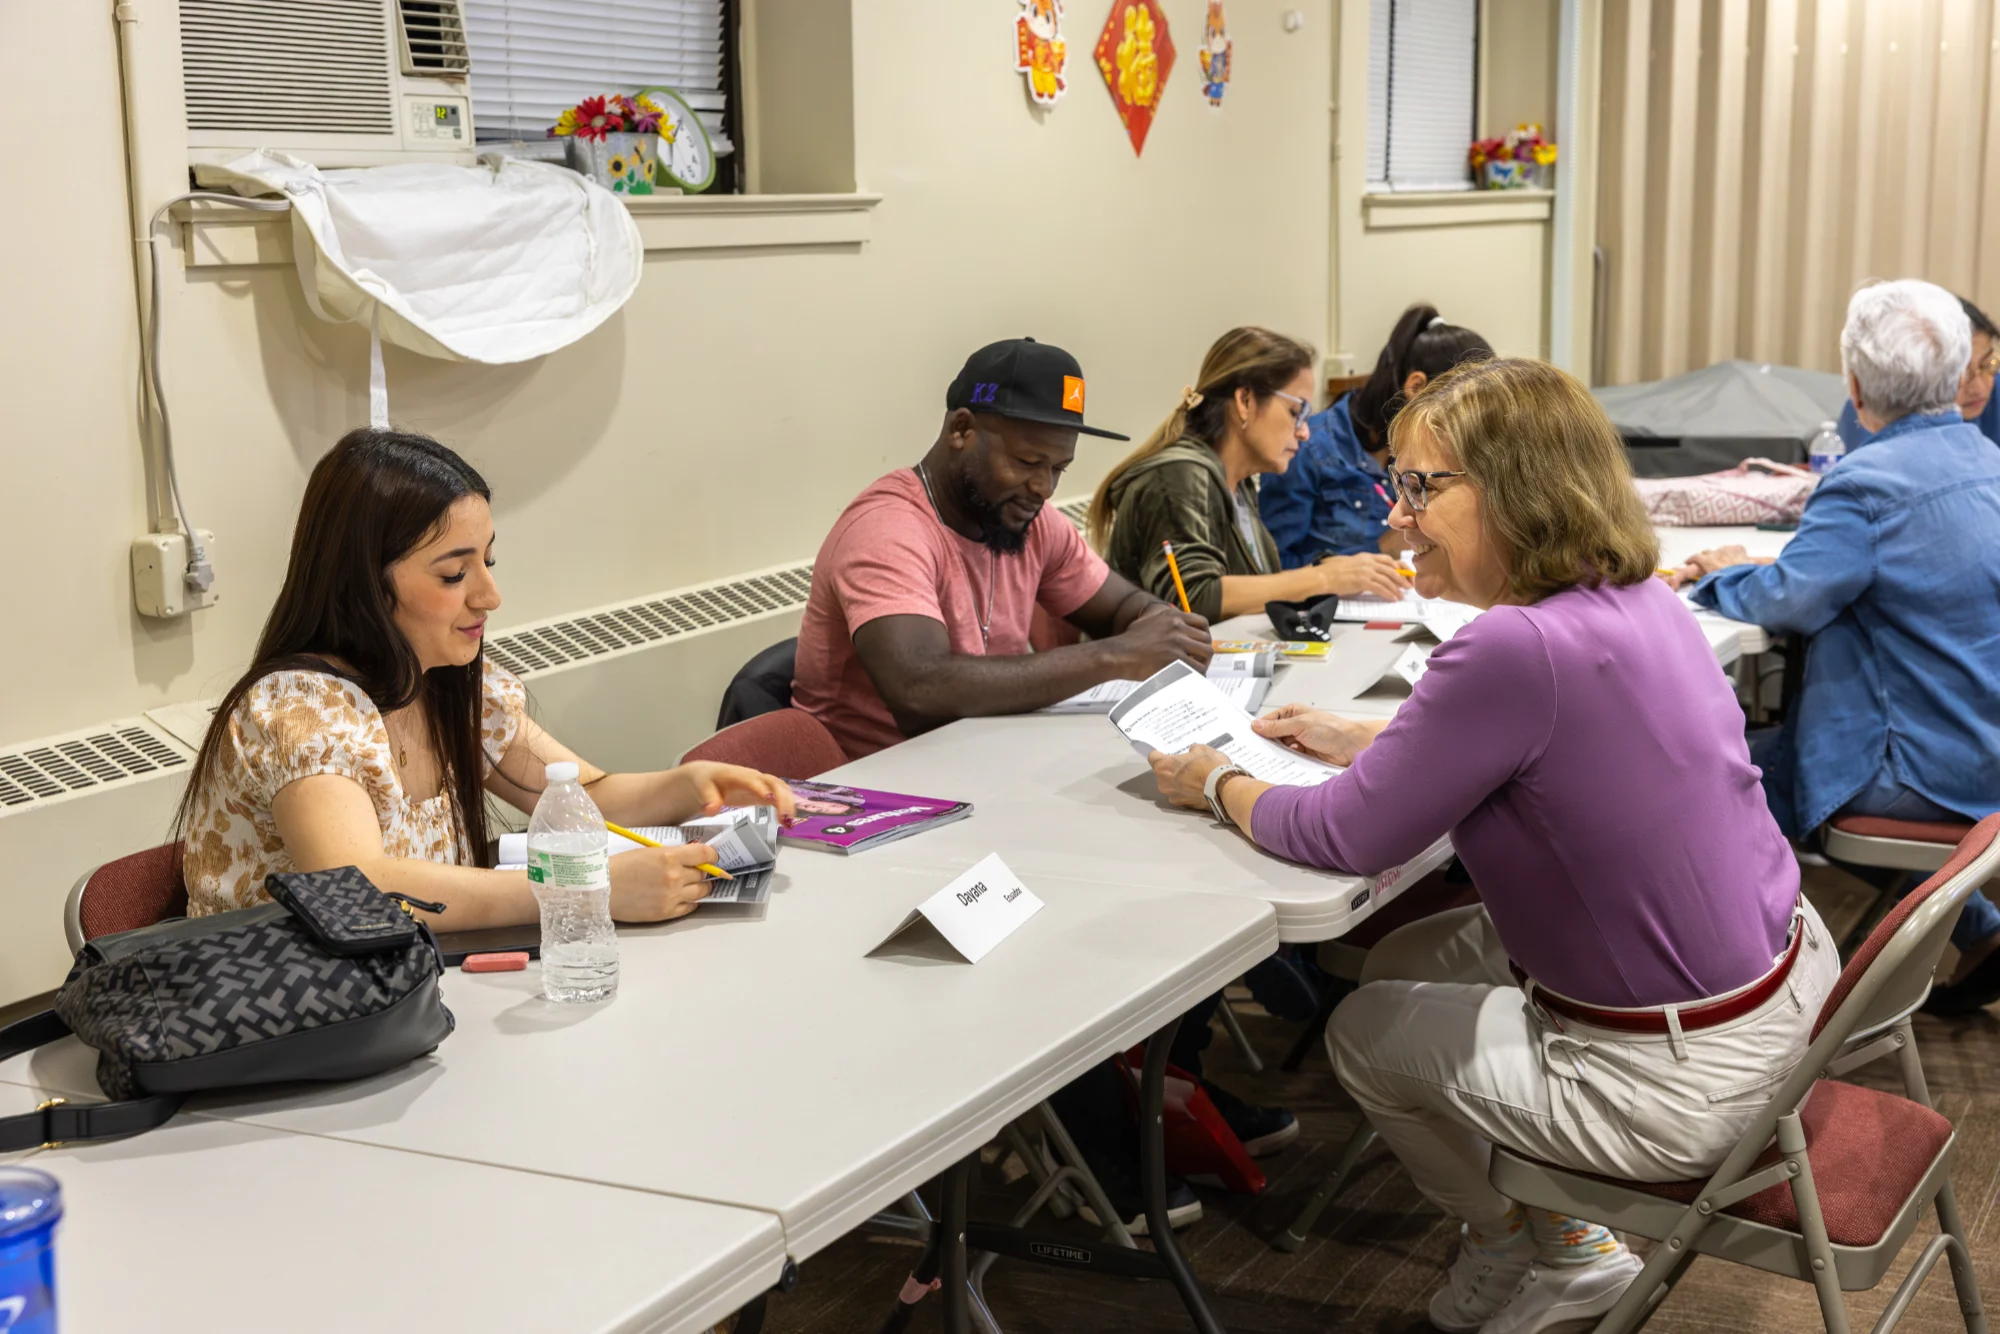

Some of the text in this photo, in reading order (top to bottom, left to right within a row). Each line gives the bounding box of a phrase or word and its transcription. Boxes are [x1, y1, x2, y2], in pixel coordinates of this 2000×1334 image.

[1116, 4, 1157, 107] 福
[956, 881, 988, 907] Dayana
[1037, 1245, 1084, 1260] LIFETIME
